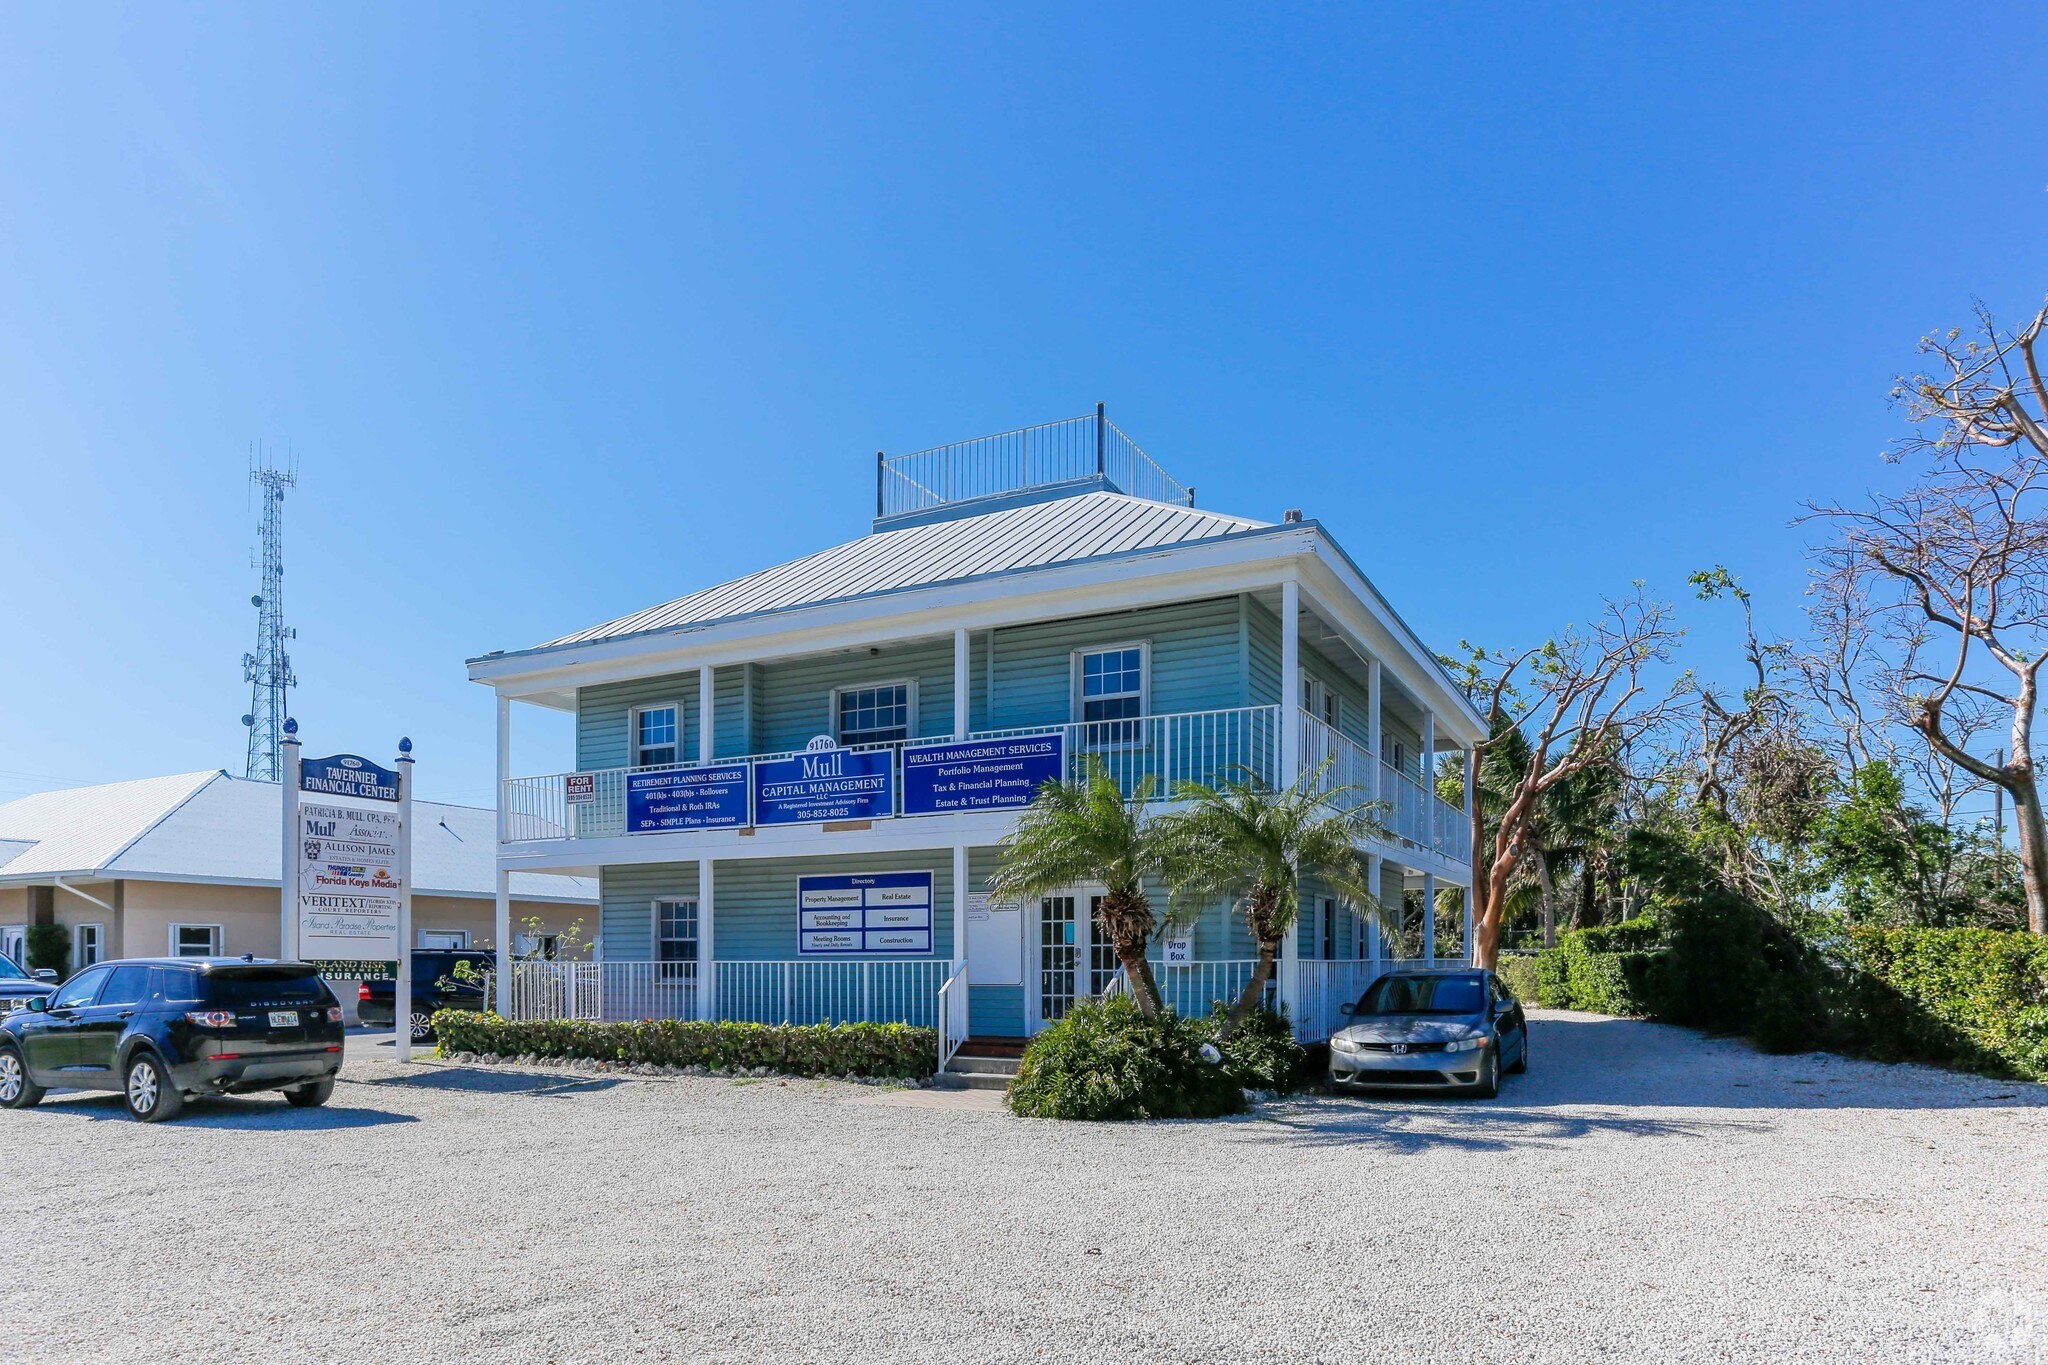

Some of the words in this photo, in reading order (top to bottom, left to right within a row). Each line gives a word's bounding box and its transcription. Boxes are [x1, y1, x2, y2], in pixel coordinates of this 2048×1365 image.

[810, 740, 834, 750] 91760
[909, 753, 943, 763] WEALTH
[946, 747, 1006, 760] MANAGEMENT
[1008, 743, 1051, 754] SERVICES
[802, 753, 843, 779] Mull
[938, 765, 971, 776] Portfolio
[973, 763, 1023, 774] Management
[326, 767, 377, 785] TAVERNIER
[571, 777, 589, 785] FOR
[633, 777, 672, 787] RETIREMENT
[674, 775, 707, 784] PLANNING
[708, 772, 741, 781] SERVICES
[305, 777, 357, 795] FINANCIAL
[360, 784, 396, 799] CENTER
[568, 785, 592, 793] RENT
[762, 785, 805, 797] CAPITAL
[810, 778, 885, 793] MANAGEMENT
[933, 784, 946, 792] Tax
[958, 781, 992, 790] Financial
[995, 779, 1030, 788] Planning
[671, 790, 695, 798] 403(b)s
[700, 788, 728, 796] Rollovers
[784, 802, 807, 810] Registered
[970, 797, 989, 805] Trust
[992, 795, 1026, 804] Planning
[304, 806, 336, 819] PATRICIA
[649, 804, 680, 814] Traditional
[689, 803, 704, 811] Roth
[797, 808, 848, 819] 305-852-8025
[306, 820, 336, 837] Mull
[660, 818, 683, 826] SIMPLE
[324, 842, 365, 853] ALLISON
[368, 846, 395, 856] JAMES
[316, 875, 346, 886] Florida
[349, 878, 369, 888] Keys
[372, 879, 397, 888] Media
[302, 916, 329, 929] Island
[332, 917, 362, 930] Paradise
[364, 918, 396, 931] Properties
[1168, 940, 1186, 950] Drop
[1170, 952, 1185, 960] Box
